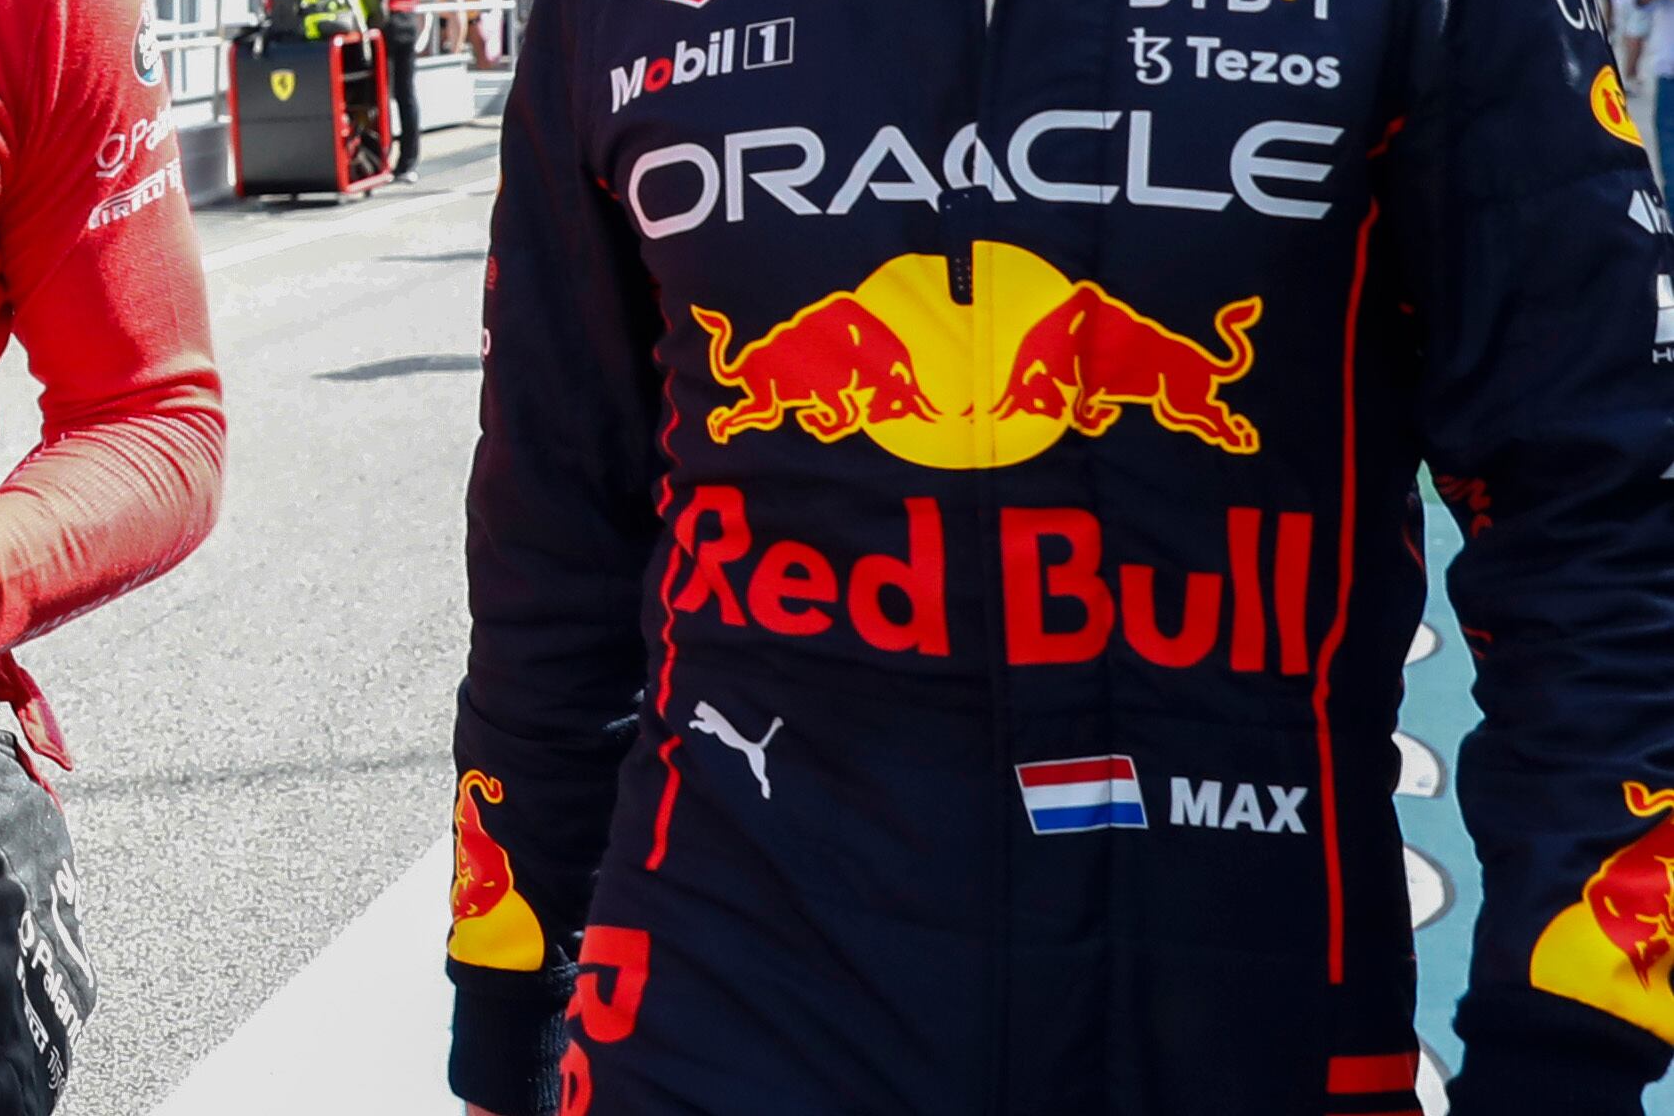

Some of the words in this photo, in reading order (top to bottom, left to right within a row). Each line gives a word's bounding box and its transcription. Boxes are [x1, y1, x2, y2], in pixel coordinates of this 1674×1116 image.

[610, 28, 735, 114] Mobil
[1186, 37, 1342, 89] Tezos
[628, 110, 1345, 239] ORACLE
[673, 485, 951, 658] Red
[1000, 506, 1314, 676] Bull
[1169, 777, 1309, 834] MAX
